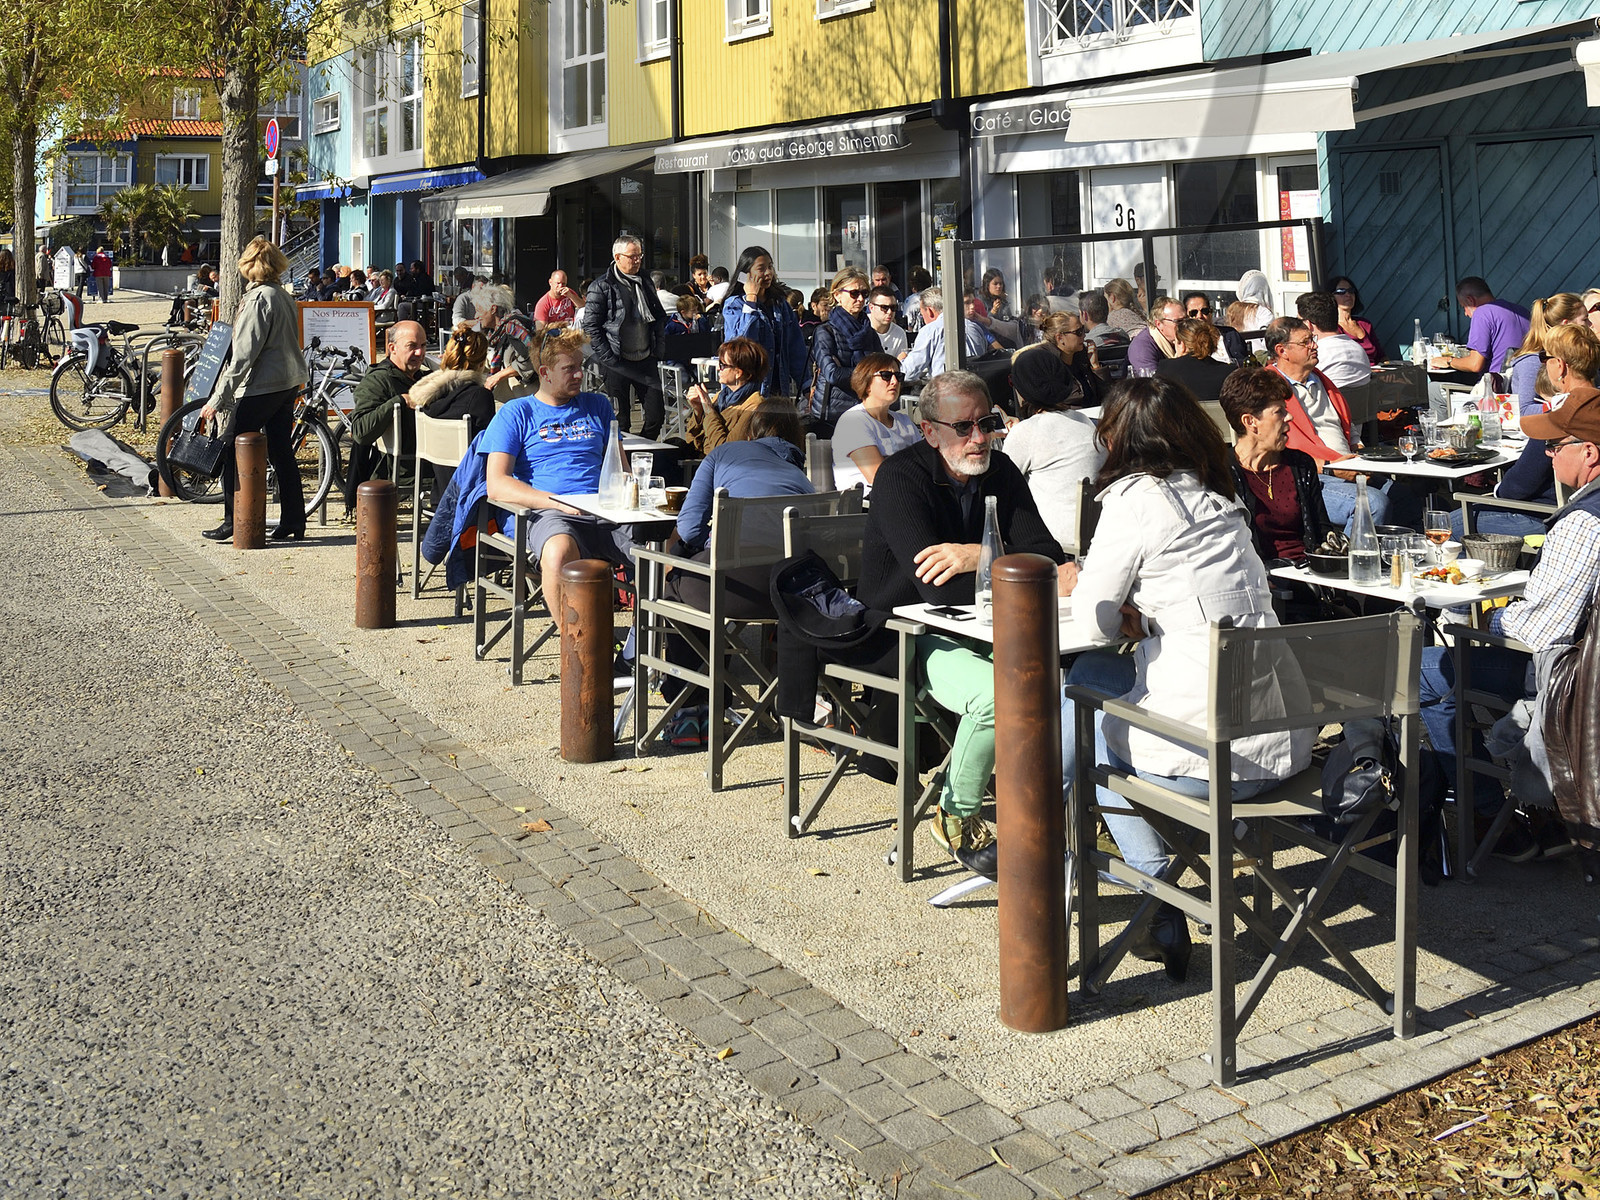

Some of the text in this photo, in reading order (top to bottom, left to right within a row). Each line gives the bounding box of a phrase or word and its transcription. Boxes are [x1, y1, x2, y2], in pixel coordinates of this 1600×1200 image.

[973, 111, 1012, 131] Café
[658, 153, 709, 170] Restaurant
[759, 143, 784, 161] quai
[788, 140, 834, 156] George
[839, 133, 899, 152] Simenon
[1115, 203, 1136, 231] 36
[312, 309, 360, 318] Nos Pizzas
